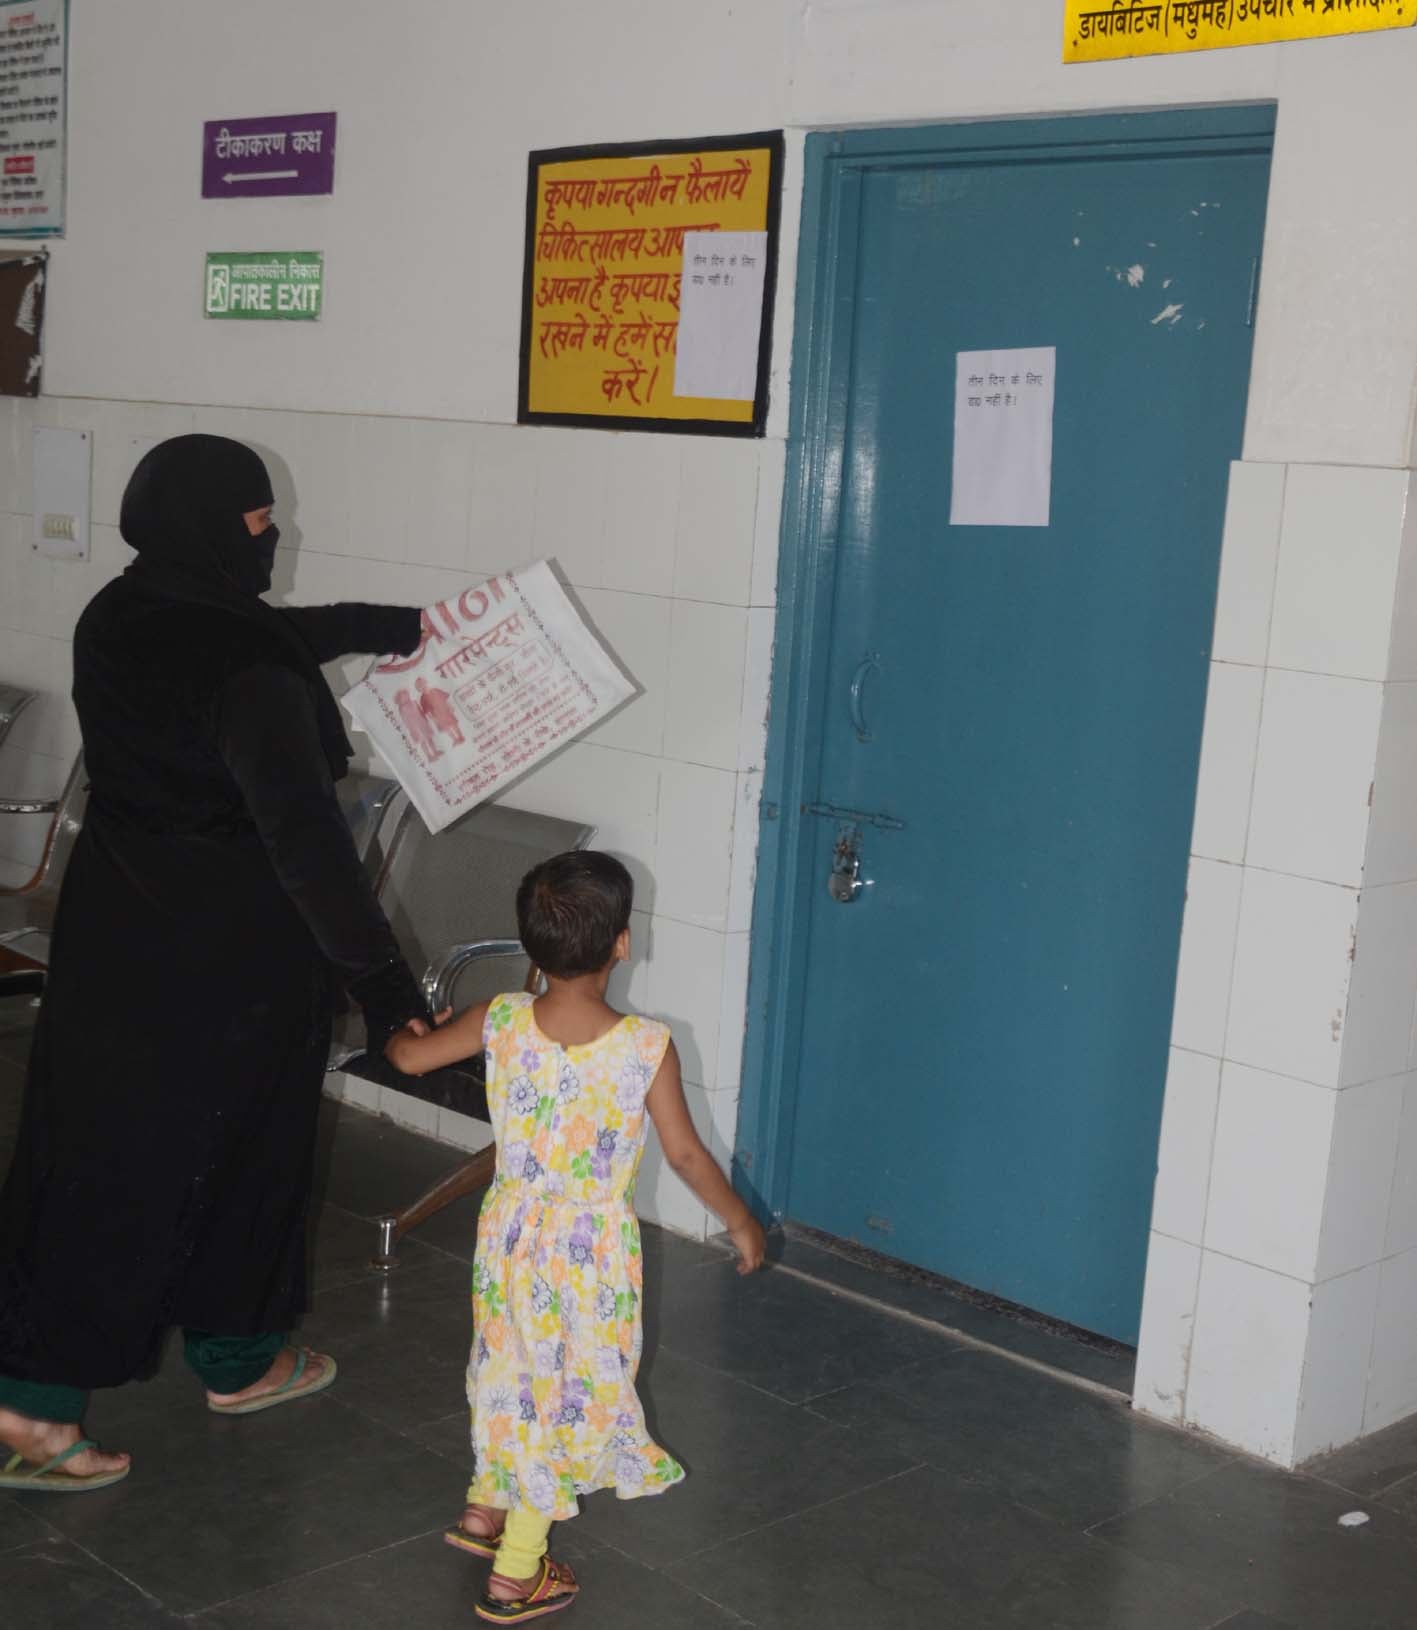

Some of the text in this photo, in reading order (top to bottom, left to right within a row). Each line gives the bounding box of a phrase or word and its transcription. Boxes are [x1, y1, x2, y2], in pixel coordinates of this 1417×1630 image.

[215, 127, 323, 158] टीकाकरण कक्ष
[544, 180, 598, 220] कृपया
[659, 175, 685, 205] न
[536, 221, 646, 265] चिकित्सालय
[230, 283, 320, 311] FIRE EXIT
[536, 277, 592, 308] अपना
[589, 266, 610, 312] है
[610, 273, 670, 314] कृपया
[540, 312, 590, 358] रखने
[592, 313, 614, 351] में
[614, 312, 653, 357] हमें
